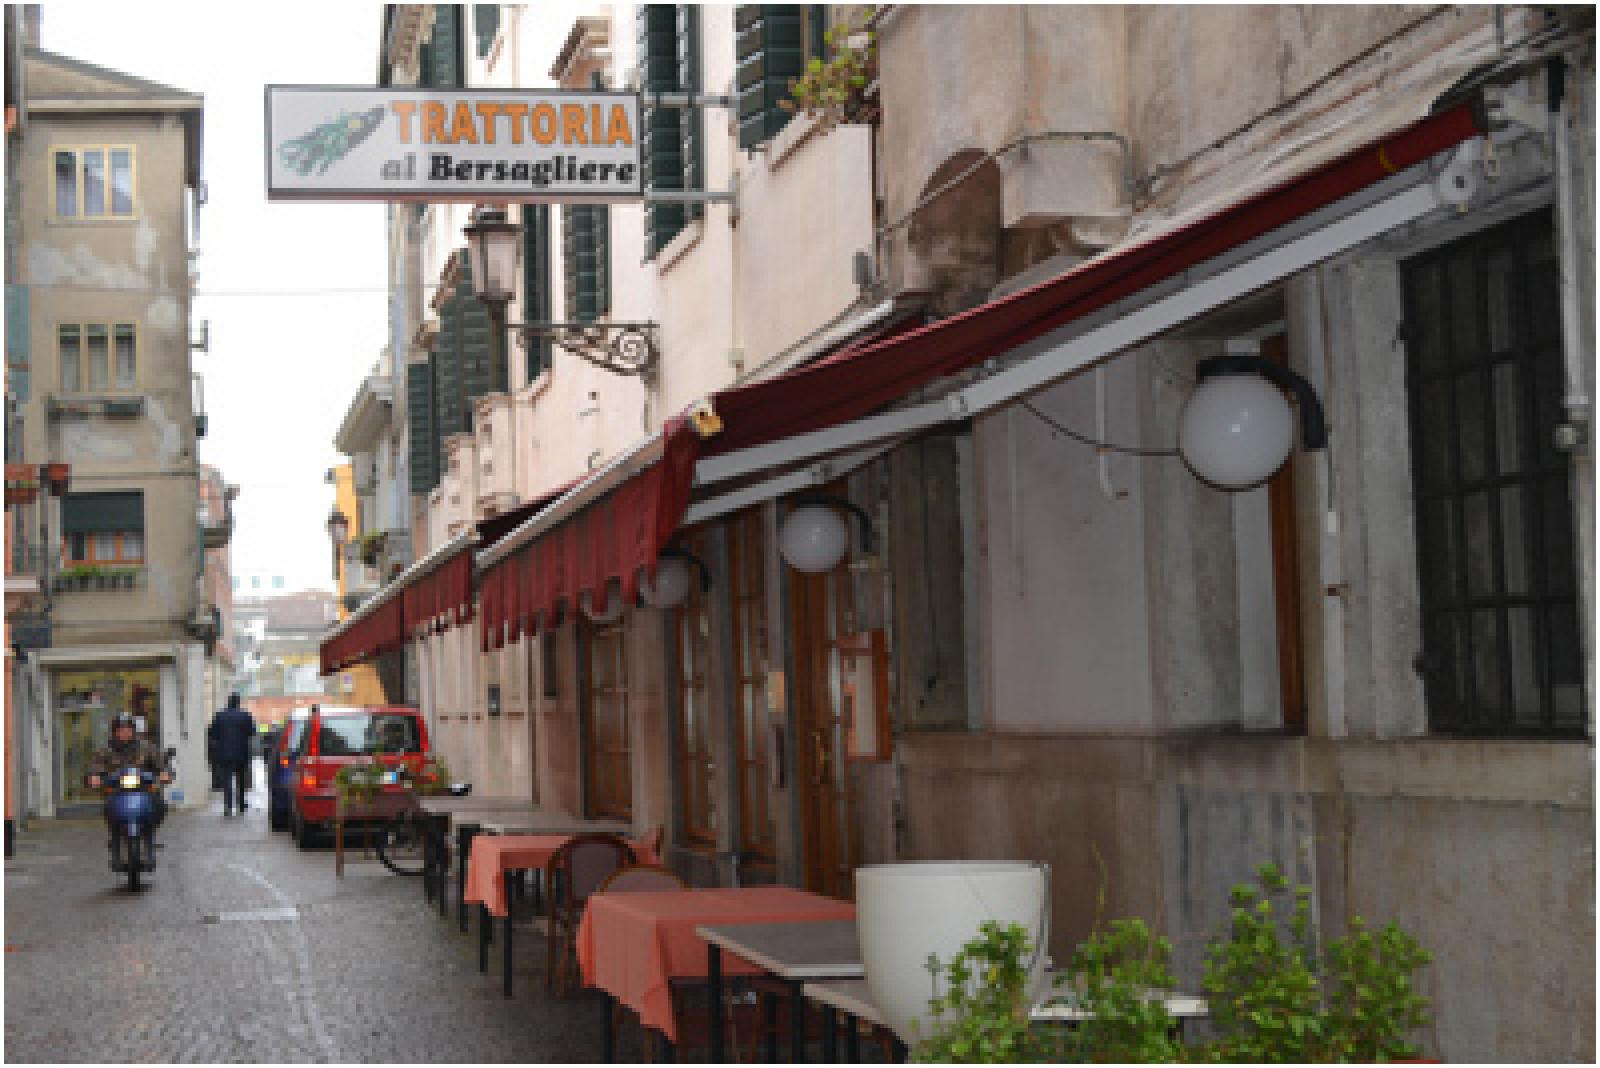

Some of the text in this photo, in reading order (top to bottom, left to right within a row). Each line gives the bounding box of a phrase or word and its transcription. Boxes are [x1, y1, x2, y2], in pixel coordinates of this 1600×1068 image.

[392, 100, 633, 145] TRATTORIA
[381, 153, 636, 187] al Bersagliere
